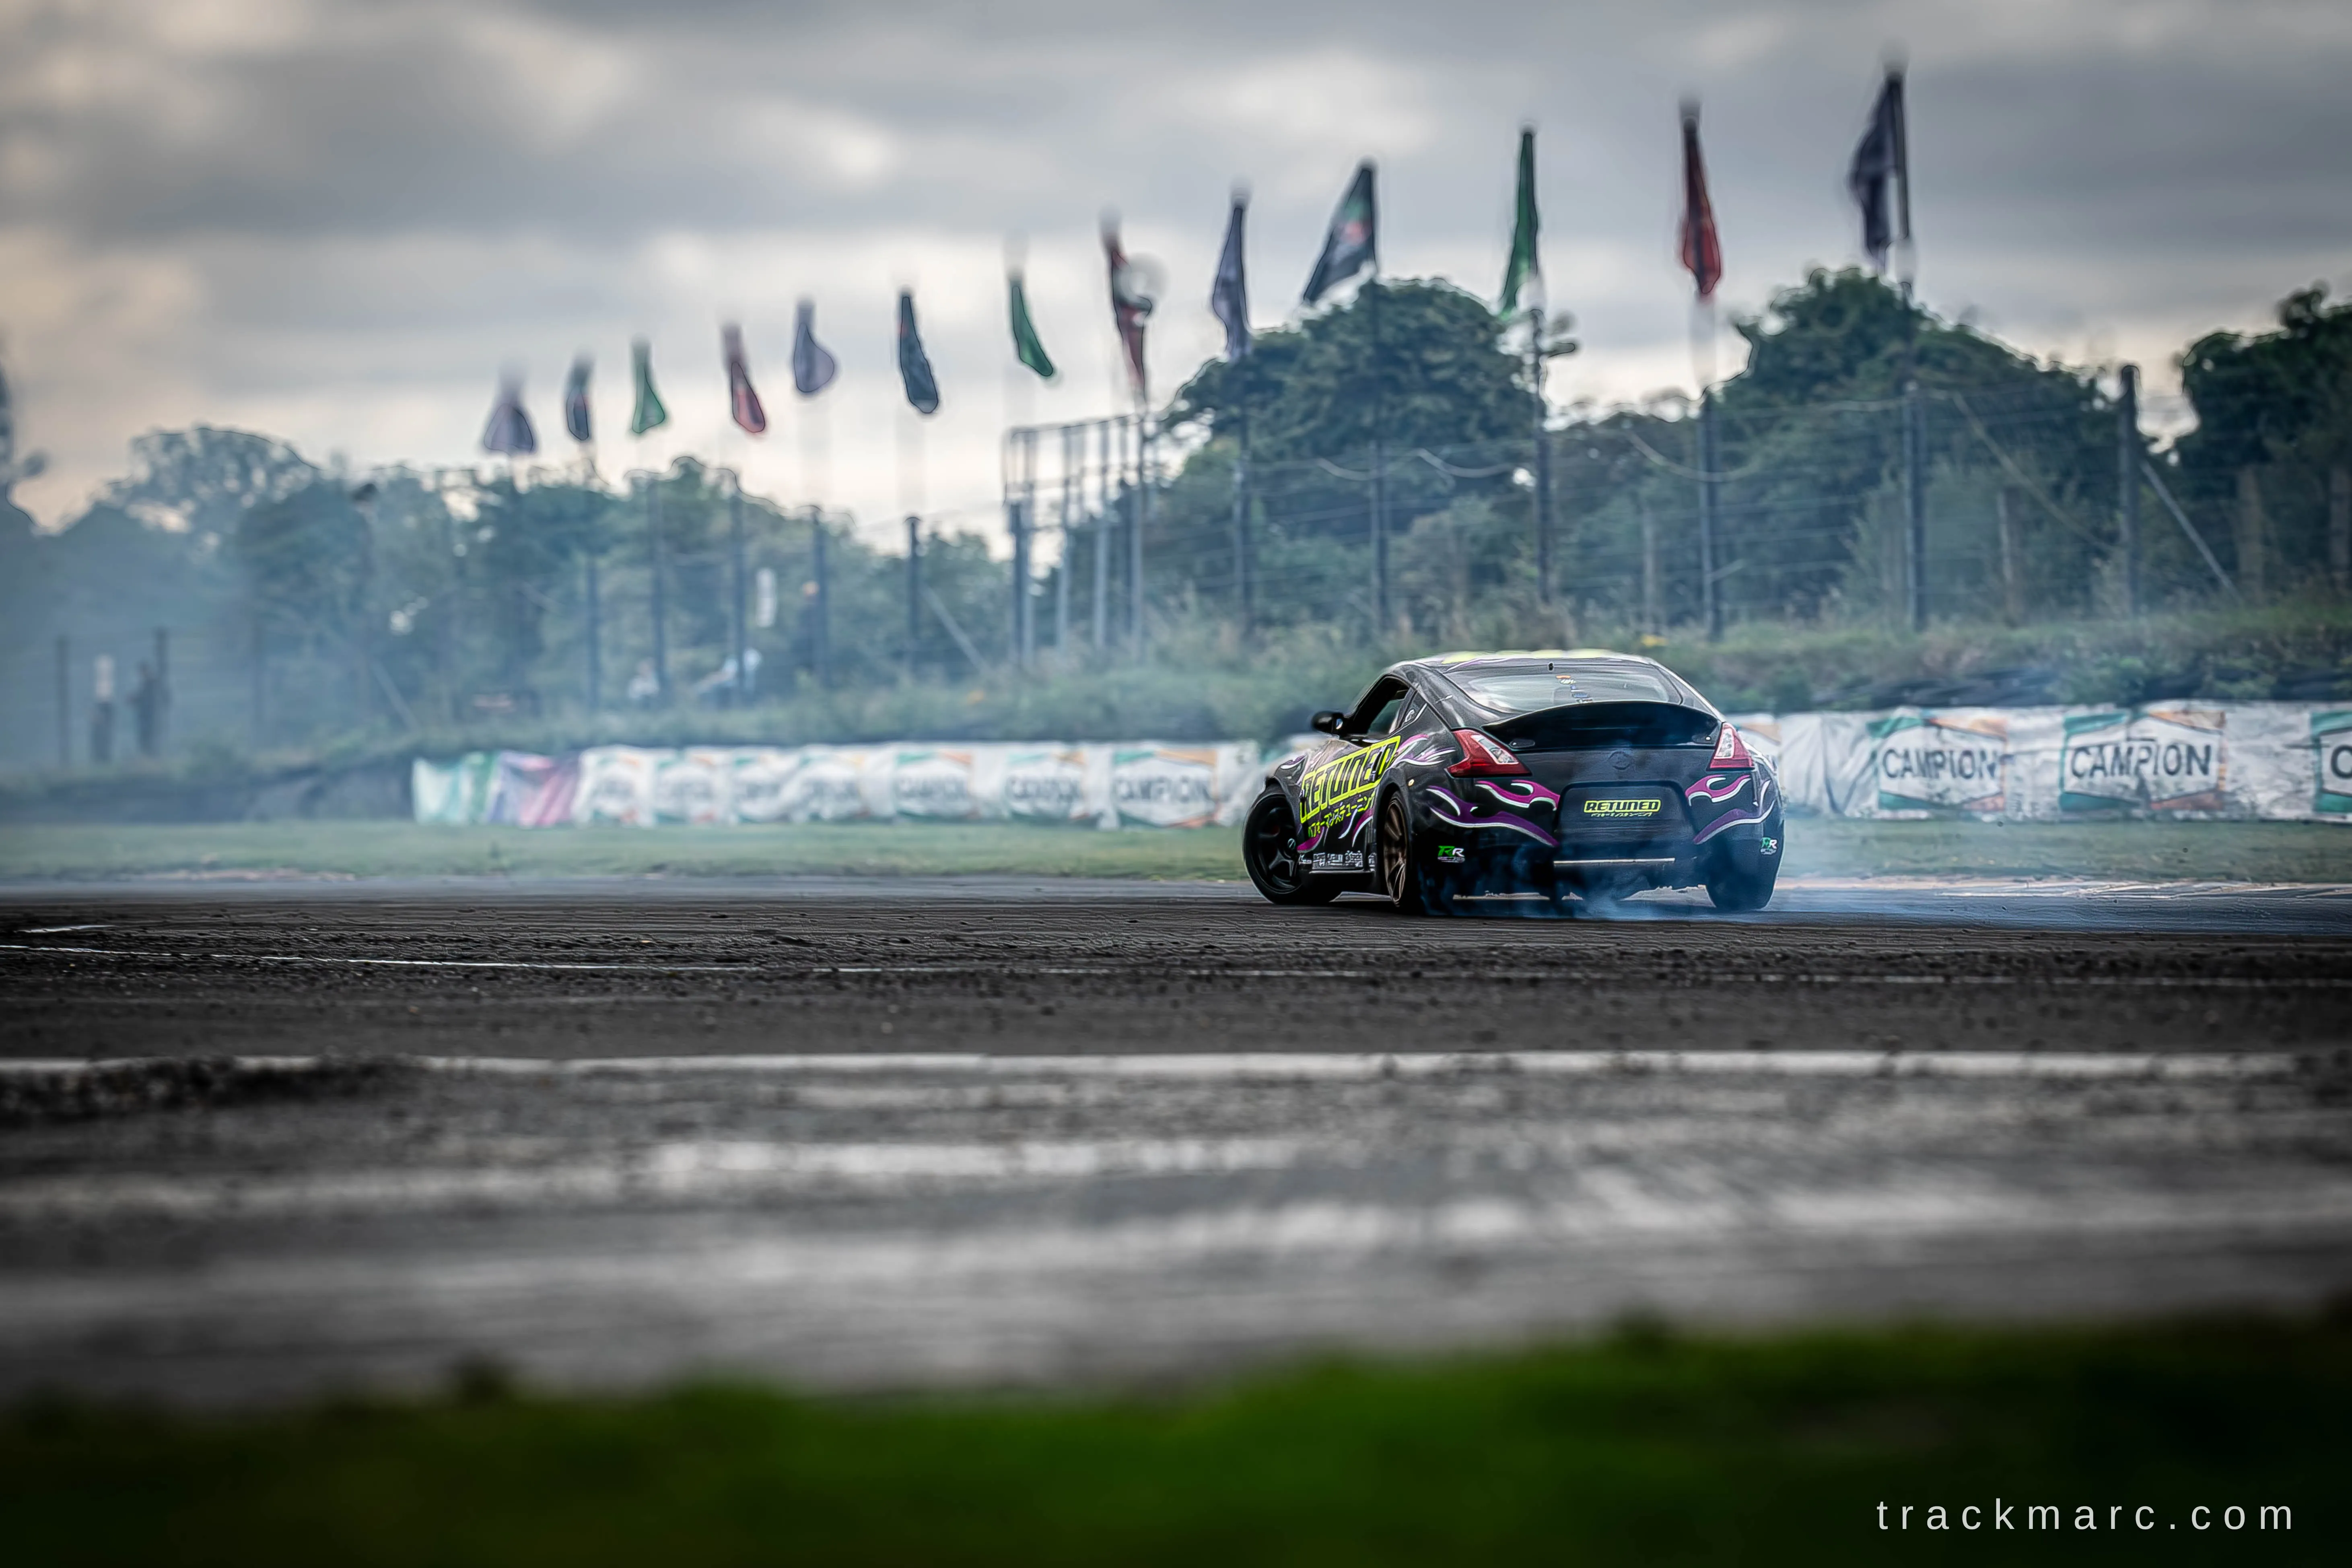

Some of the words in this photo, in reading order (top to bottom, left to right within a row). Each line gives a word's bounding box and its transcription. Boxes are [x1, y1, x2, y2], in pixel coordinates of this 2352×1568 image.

[1882, 748, 1997, 779] CAMPION
[2072, 744, 2211, 777] CAMPION
[1585, 801, 1660, 812] RETUNED
